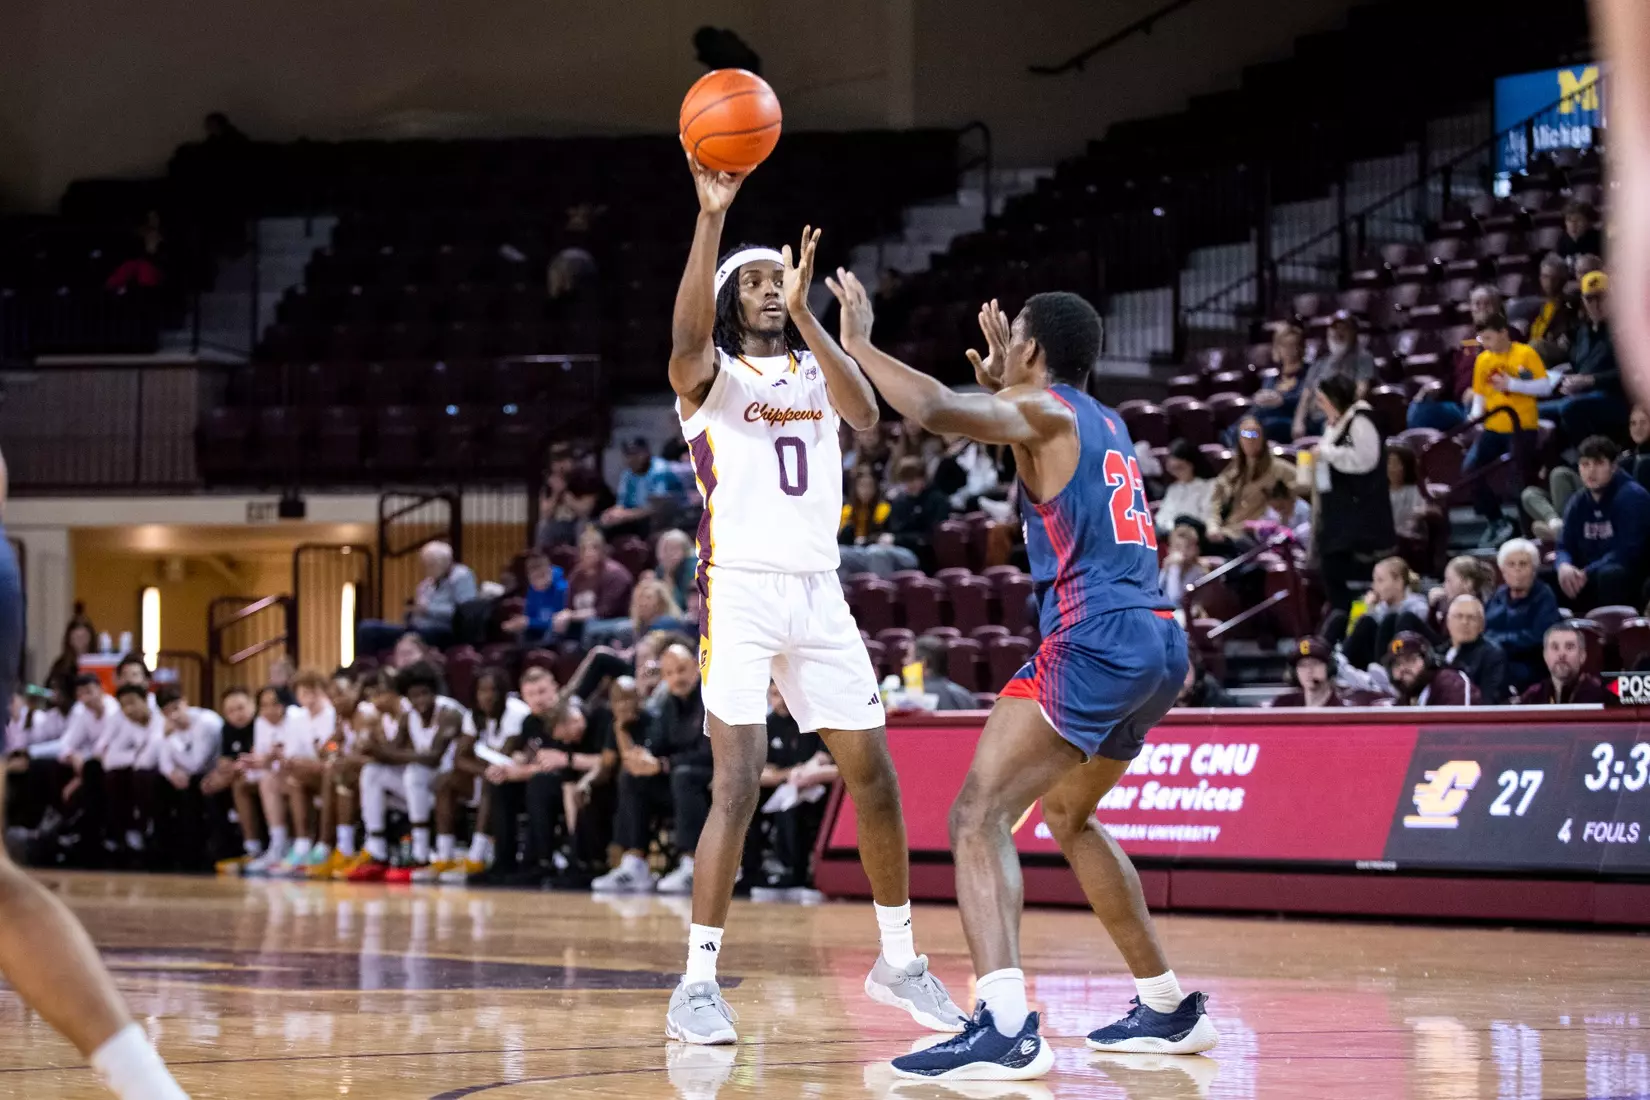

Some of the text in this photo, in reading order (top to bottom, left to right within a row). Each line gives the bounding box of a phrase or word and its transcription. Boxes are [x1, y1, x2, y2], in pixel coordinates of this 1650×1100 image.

[1558, 66, 1599, 114] M
[775, 436, 808, 497] 0
[1125, 743, 1260, 776] ECT CMU
[1585, 743, 1650, 792] 3:3
[1138, 779, 1246, 811] Services
[1489, 769, 1544, 817] 27
[1557, 818, 1641, 844] 4 FOULS
